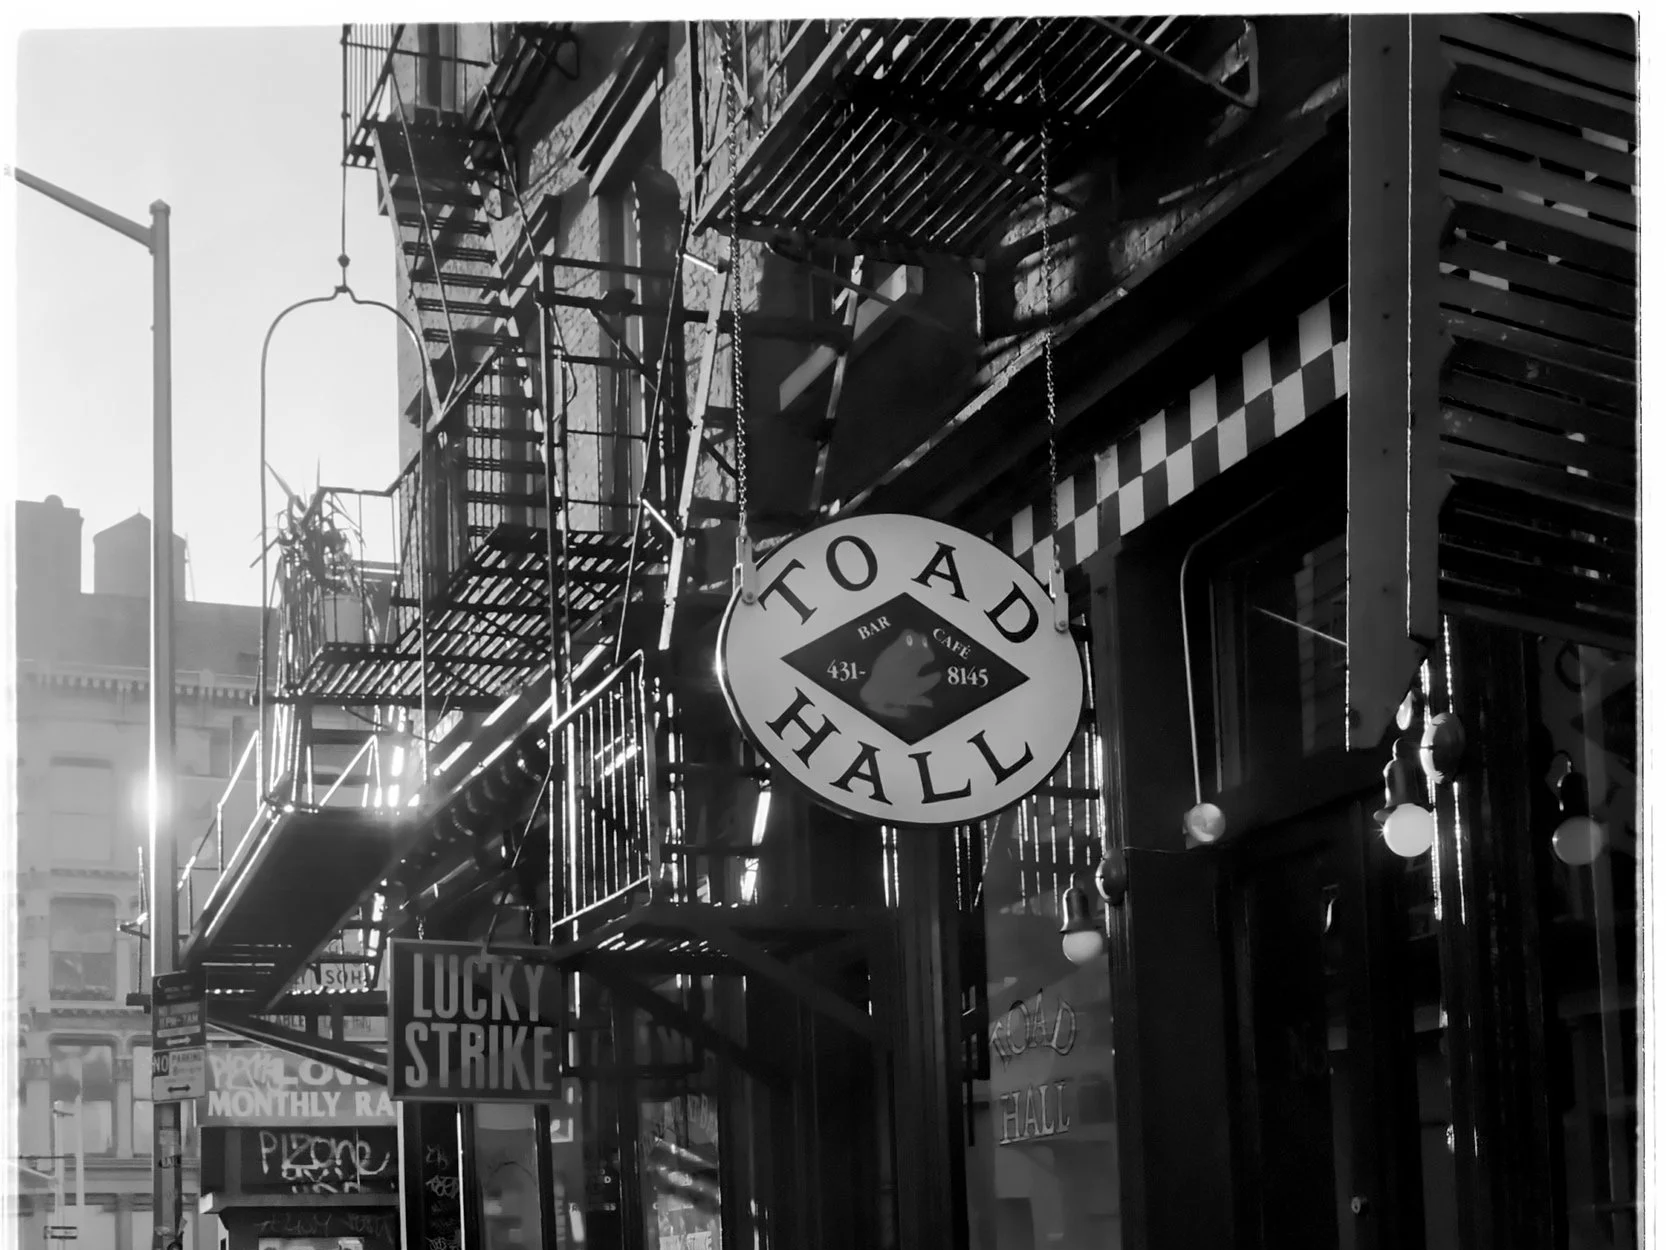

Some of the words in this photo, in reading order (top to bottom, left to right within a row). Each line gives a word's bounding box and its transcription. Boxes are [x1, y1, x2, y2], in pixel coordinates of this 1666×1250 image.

[758, 535, 1039, 643] TOAD
[857, 615, 892, 641] BAR
[932, 627, 972, 660] CAFÉ
[946, 665, 989, 688] 8145
[765, 687, 1034, 806] HALL
[413, 953, 544, 1022] LUCKY
[405, 1021, 553, 1090] STRIKE
[207, 1090, 341, 1117] MONTHLY
[999, 1080, 1071, 1146] HALL
